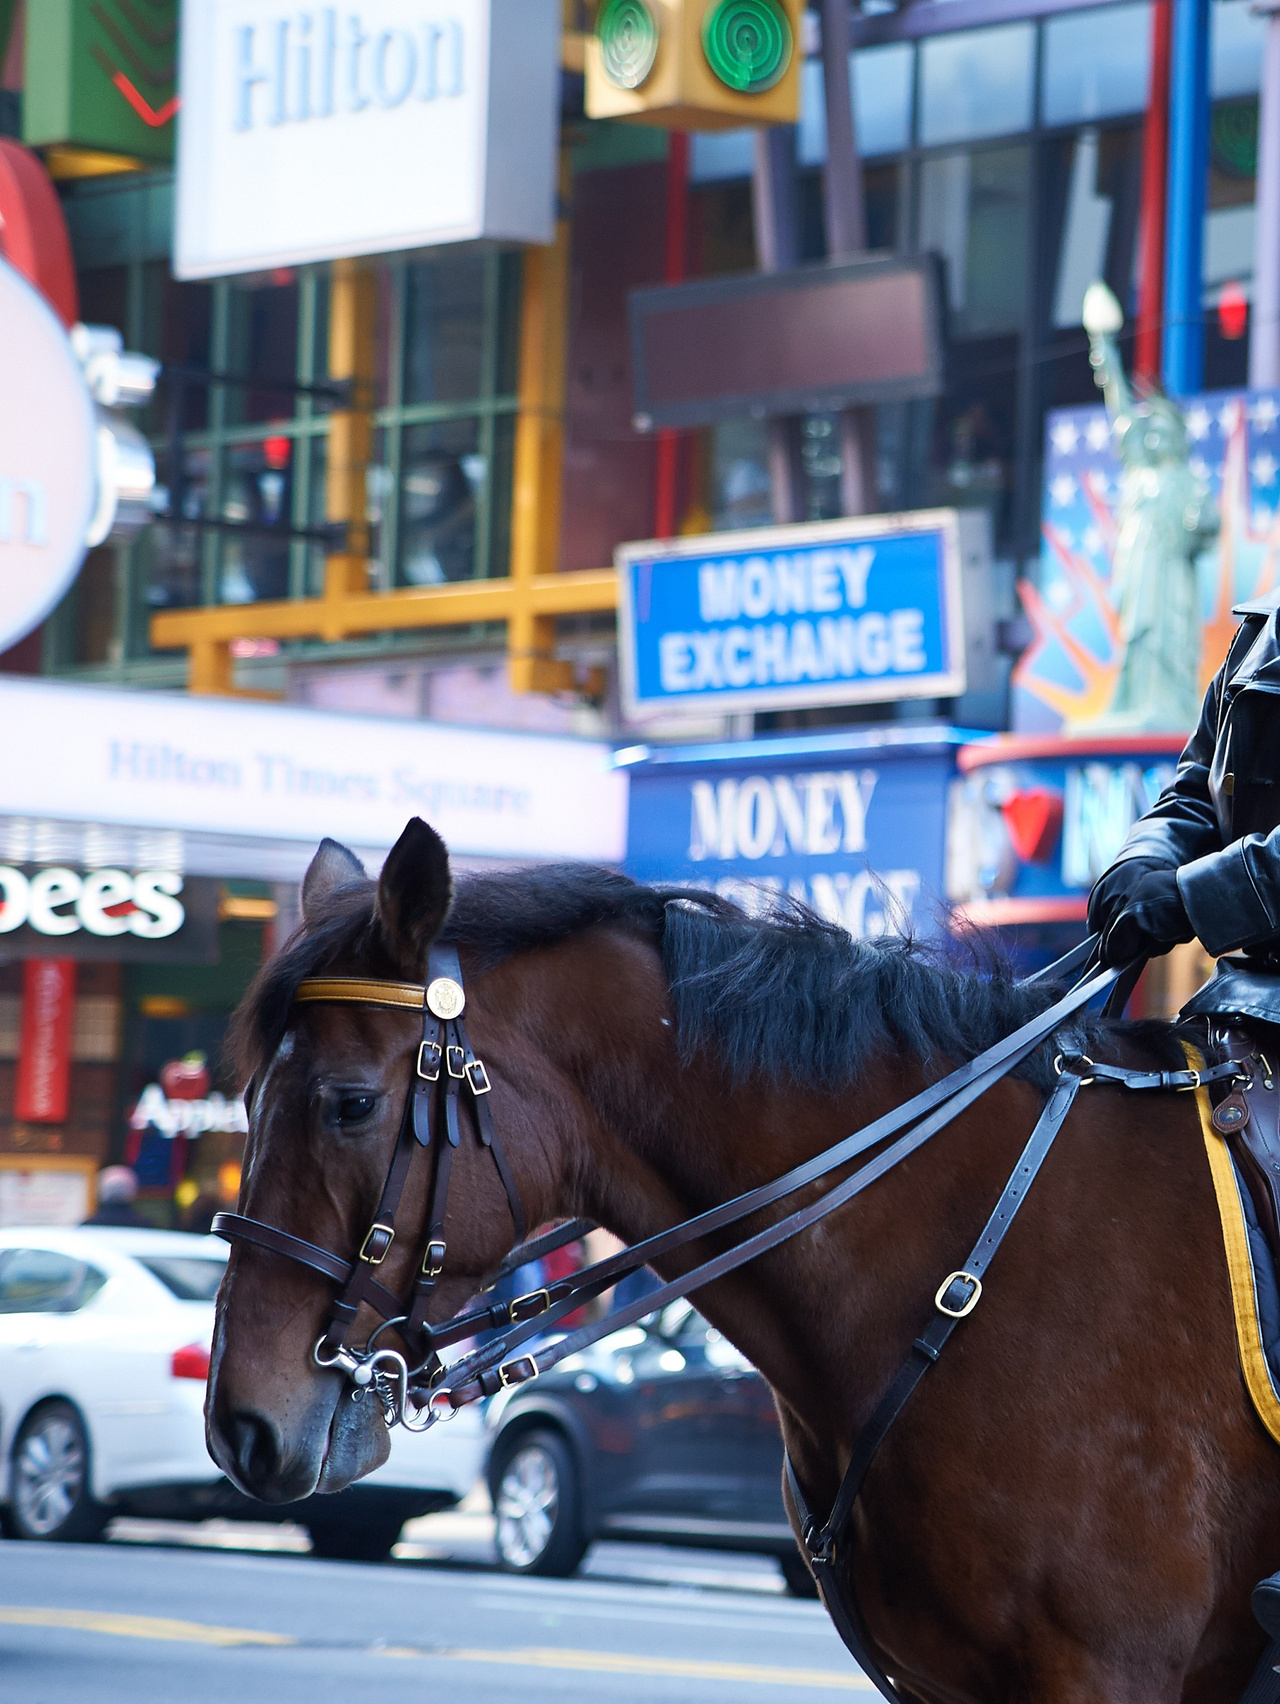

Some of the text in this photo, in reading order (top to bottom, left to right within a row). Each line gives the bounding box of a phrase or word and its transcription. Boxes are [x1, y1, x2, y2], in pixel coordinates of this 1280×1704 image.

[233, 8, 465, 132] Hilton
[698, 545, 877, 623] MONEY
[659, 608, 928, 692] EXCHANGE
[108, 738, 533, 818] Hilton Times Square
[689, 767, 879, 862] MONEY
